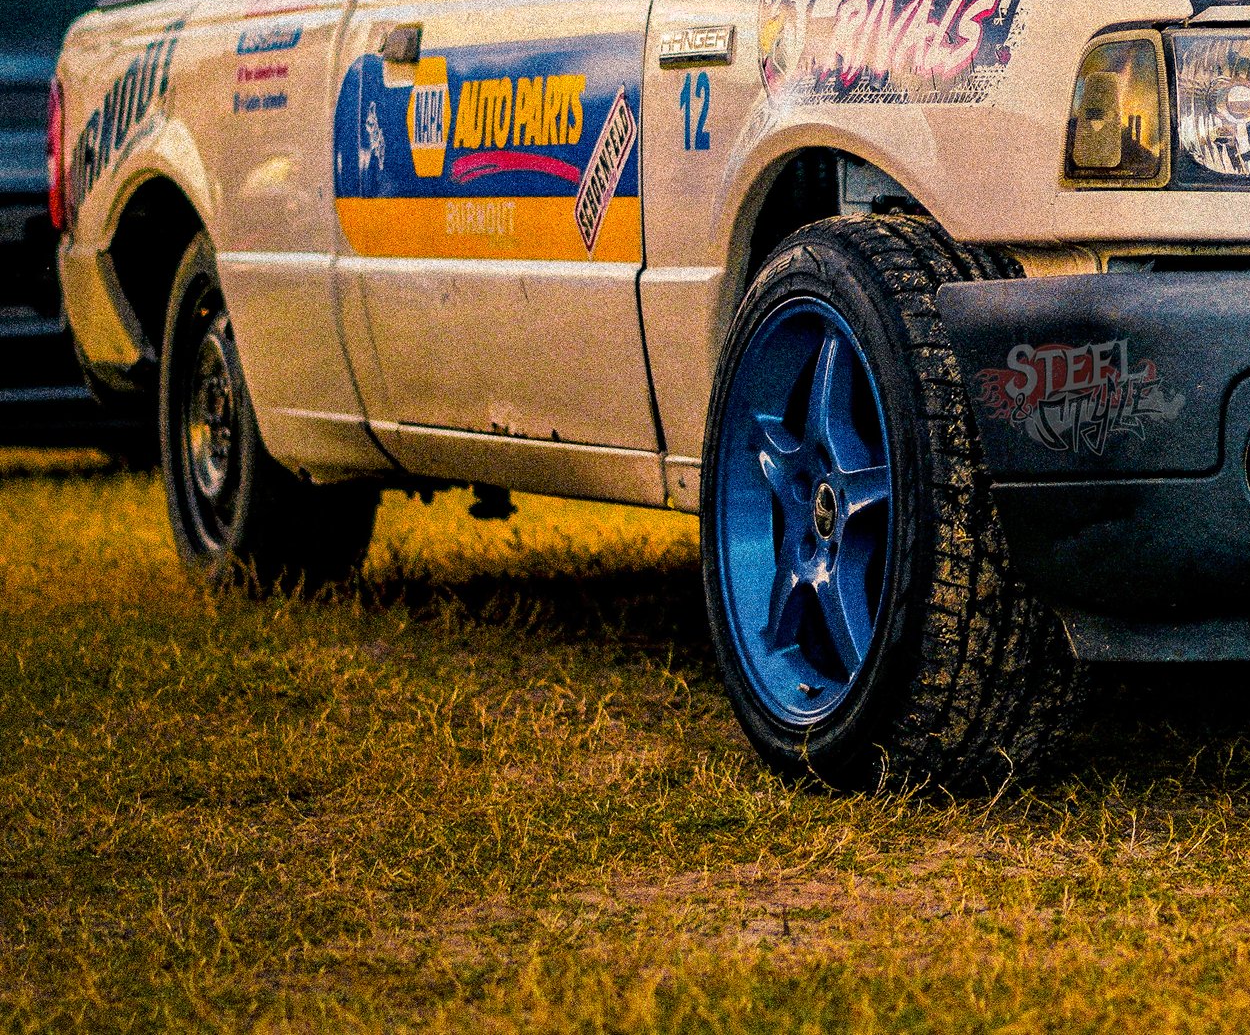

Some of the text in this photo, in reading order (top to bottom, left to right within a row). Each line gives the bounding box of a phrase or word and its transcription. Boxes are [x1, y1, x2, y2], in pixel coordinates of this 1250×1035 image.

[454, 73, 587, 149] AUTO PARTS
[679, 71, 712, 151] 12
[579, 101, 633, 241] SCHOENFELD
[1011, 391, 1033, 424] &
